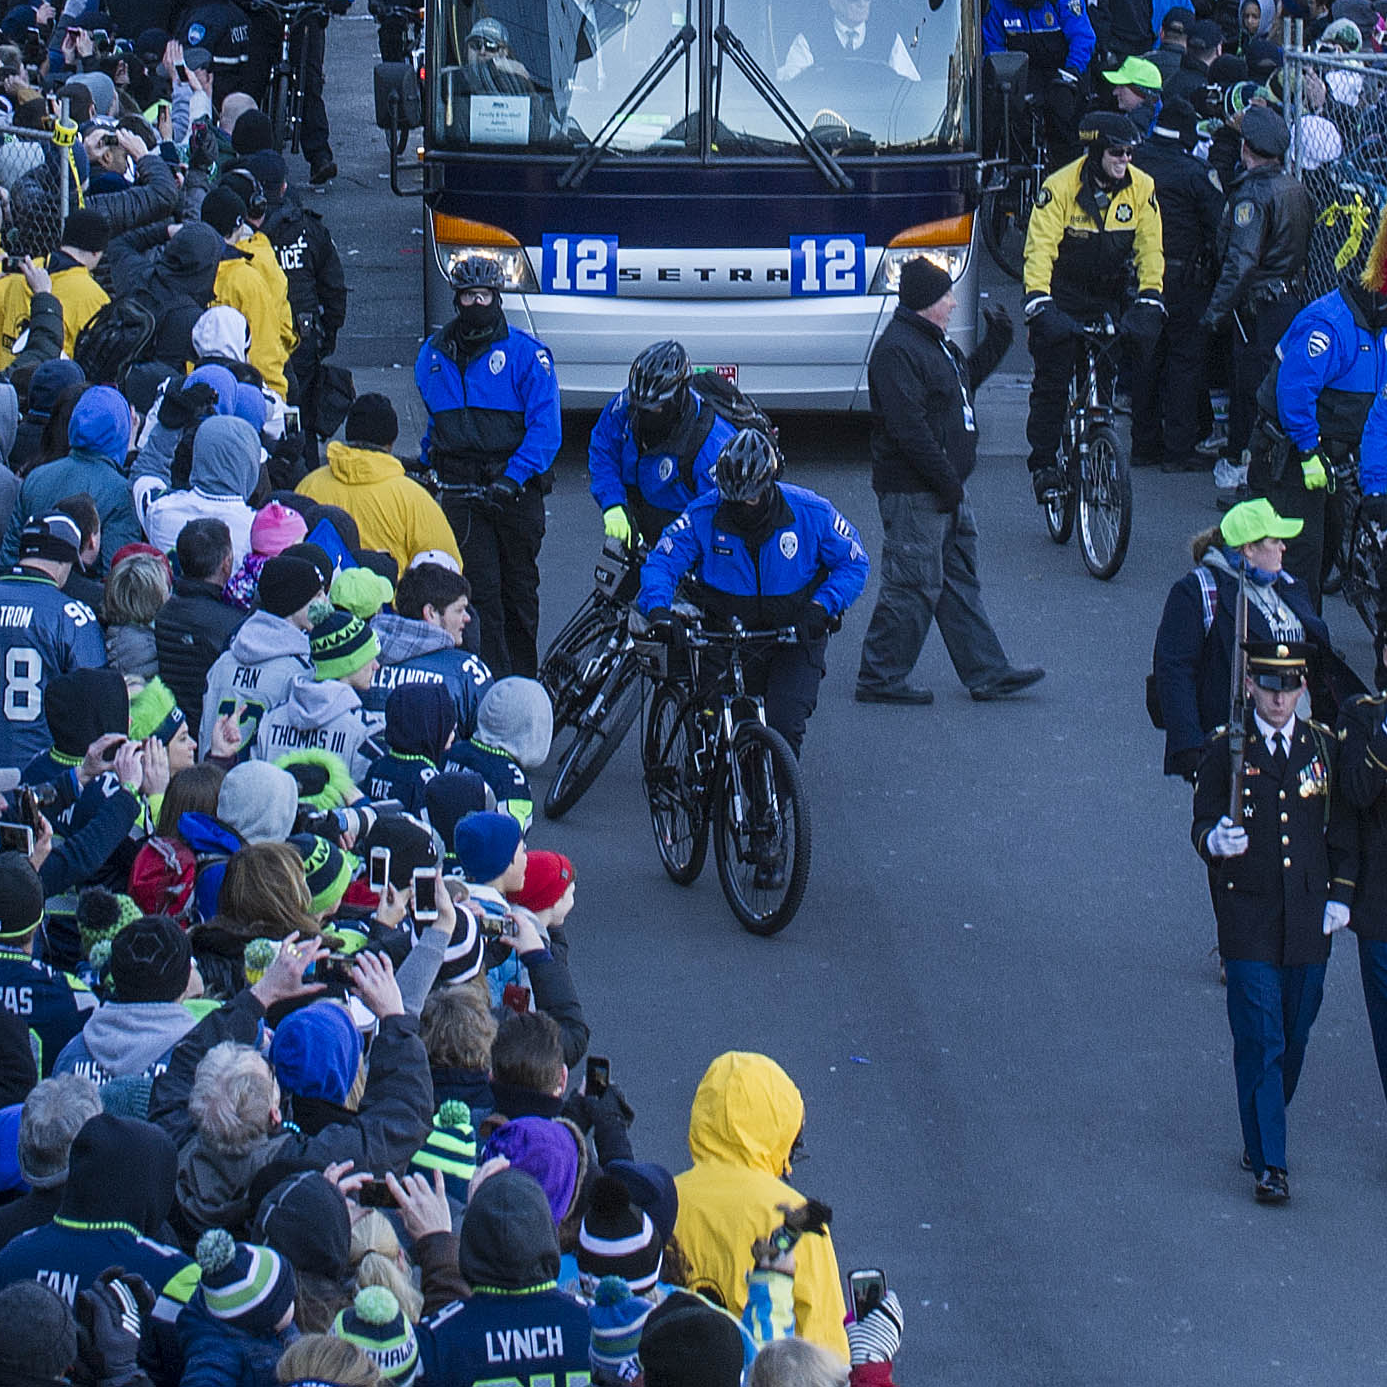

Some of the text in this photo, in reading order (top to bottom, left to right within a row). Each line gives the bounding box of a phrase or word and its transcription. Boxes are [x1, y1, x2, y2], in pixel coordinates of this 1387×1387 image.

[279, 248, 304, 271] LICE
[550, 238, 858, 292] 12 SETRA 12
[232, 667, 261, 690] FAN
[371, 665, 444, 690] LEXANDER
[271, 723, 347, 754] THOMAS III
[36, 1269, 80, 1307] FAN
[485, 1325, 564, 1363] LYNCH
